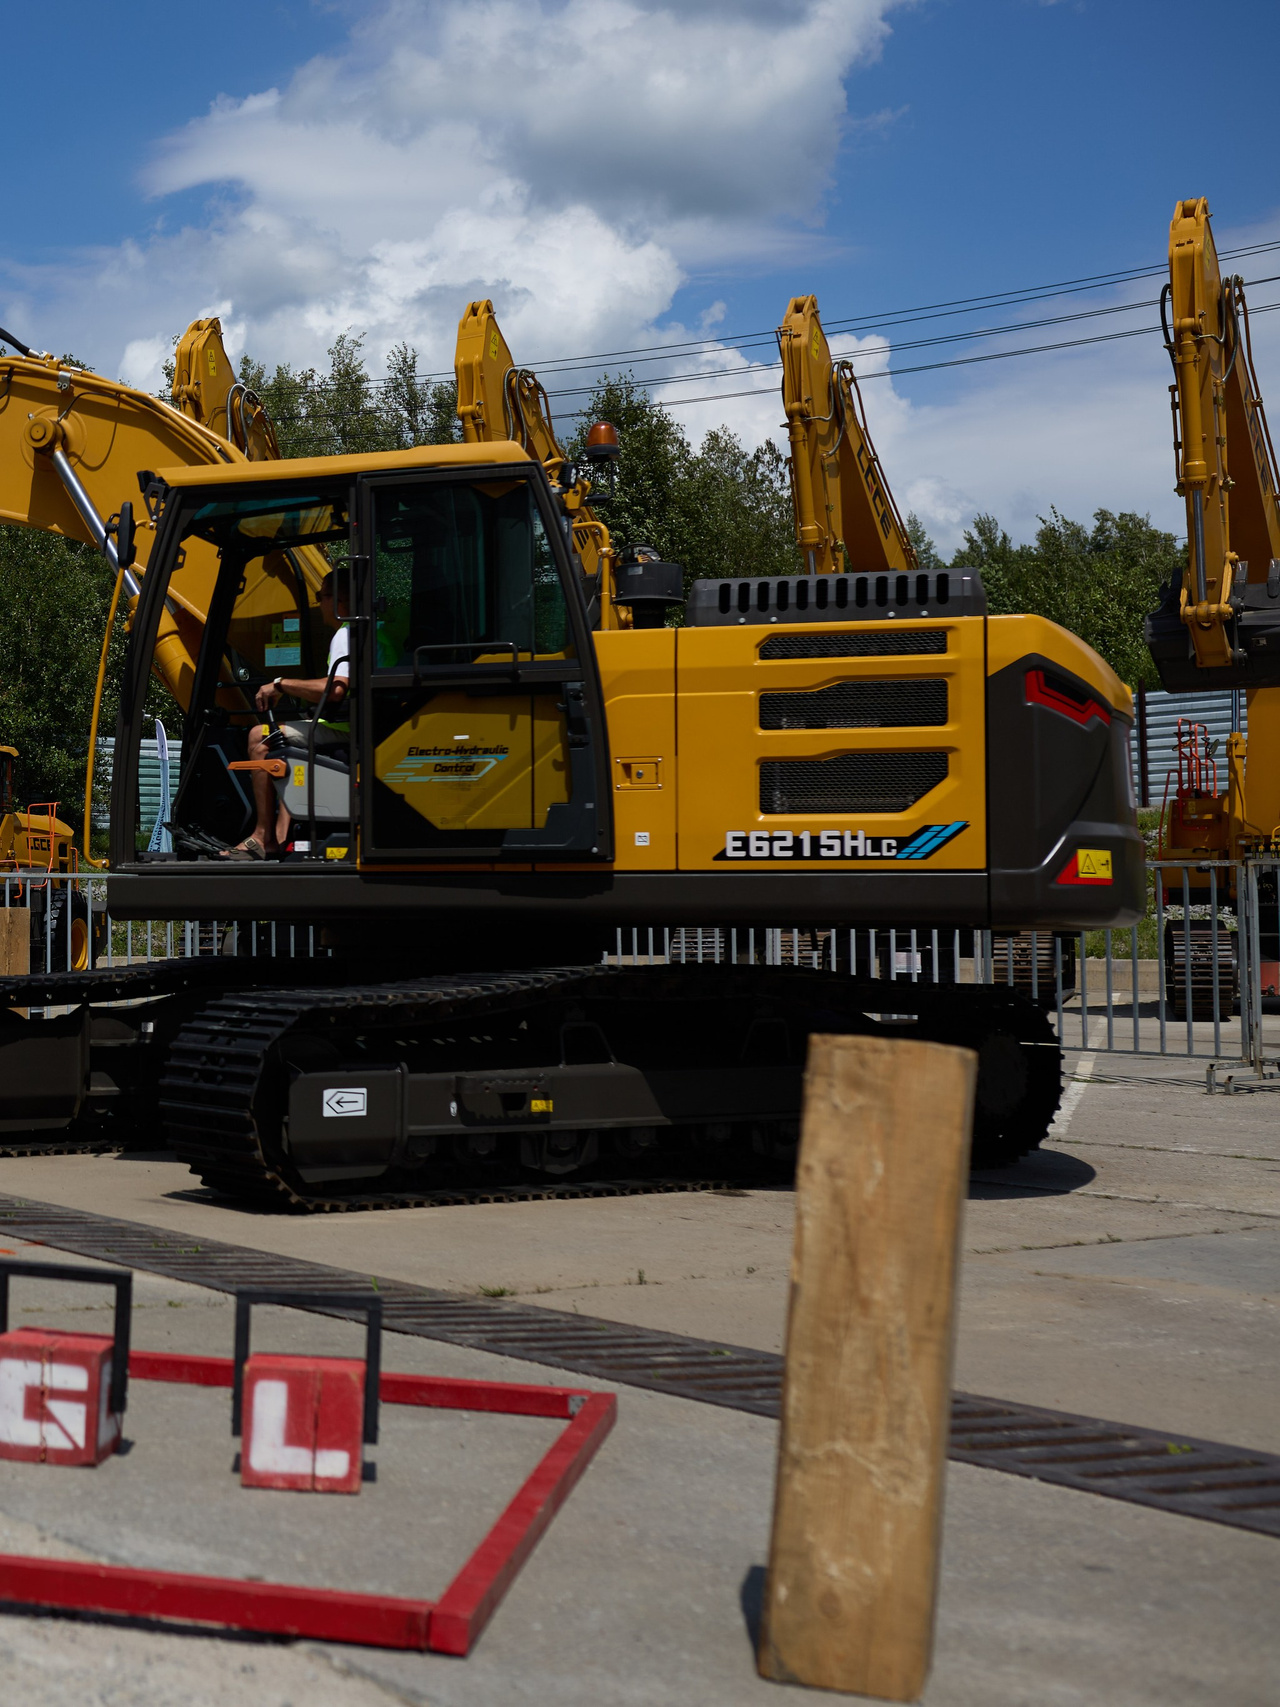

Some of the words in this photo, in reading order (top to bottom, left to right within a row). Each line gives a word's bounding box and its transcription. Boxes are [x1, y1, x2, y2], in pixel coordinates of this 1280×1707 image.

[857, 442, 892, 540] LGCE
[407, 745, 509, 756] Electro-Hydraulic
[433, 763, 476, 773] Control
[249, 1379, 350, 1479] L
